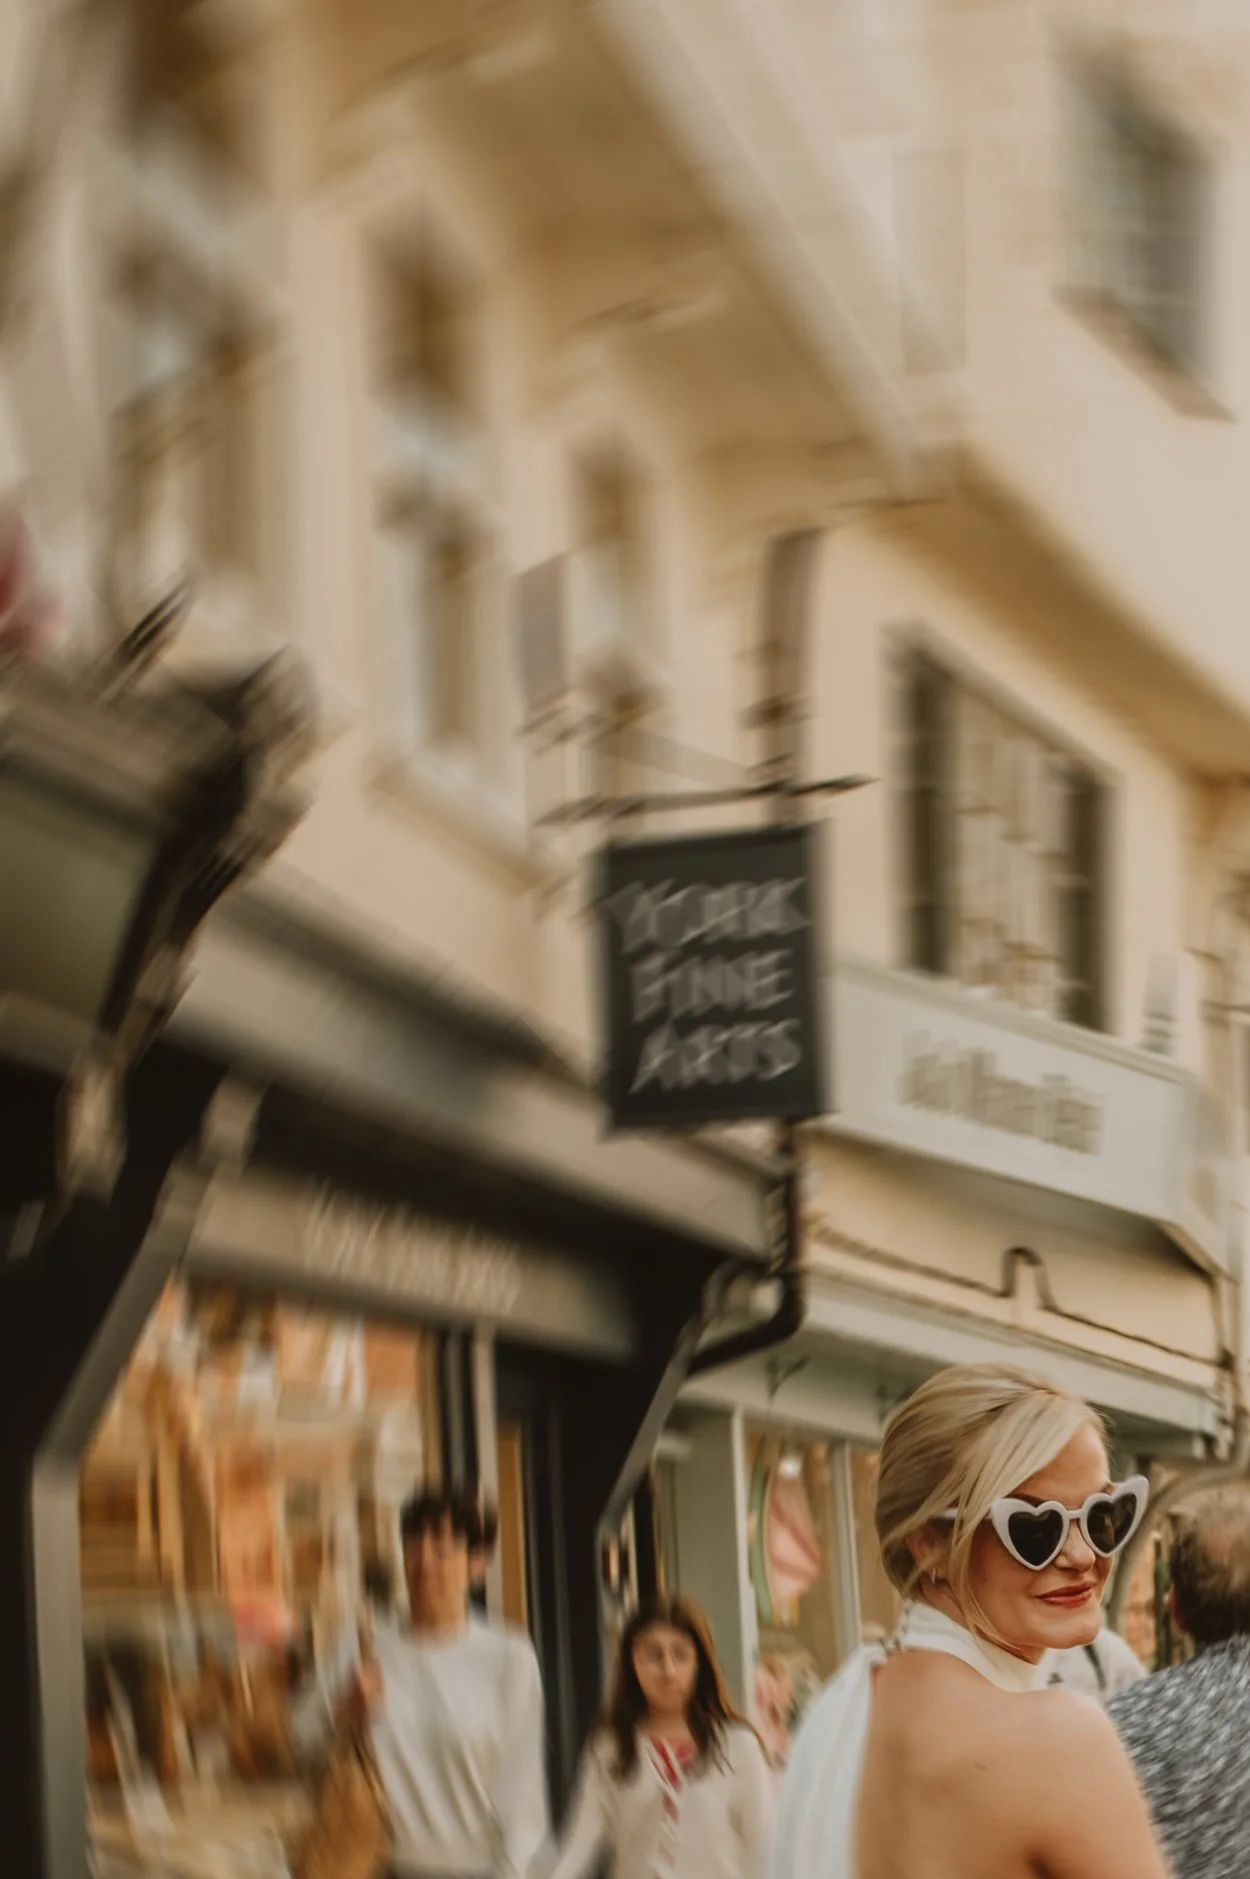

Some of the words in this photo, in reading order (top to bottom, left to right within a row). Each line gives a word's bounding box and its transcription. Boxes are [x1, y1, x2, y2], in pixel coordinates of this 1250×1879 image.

[605, 877, 811, 953] YORK
[629, 949, 794, 1024] FINE
[627, 1018, 801, 1094] ARTS
